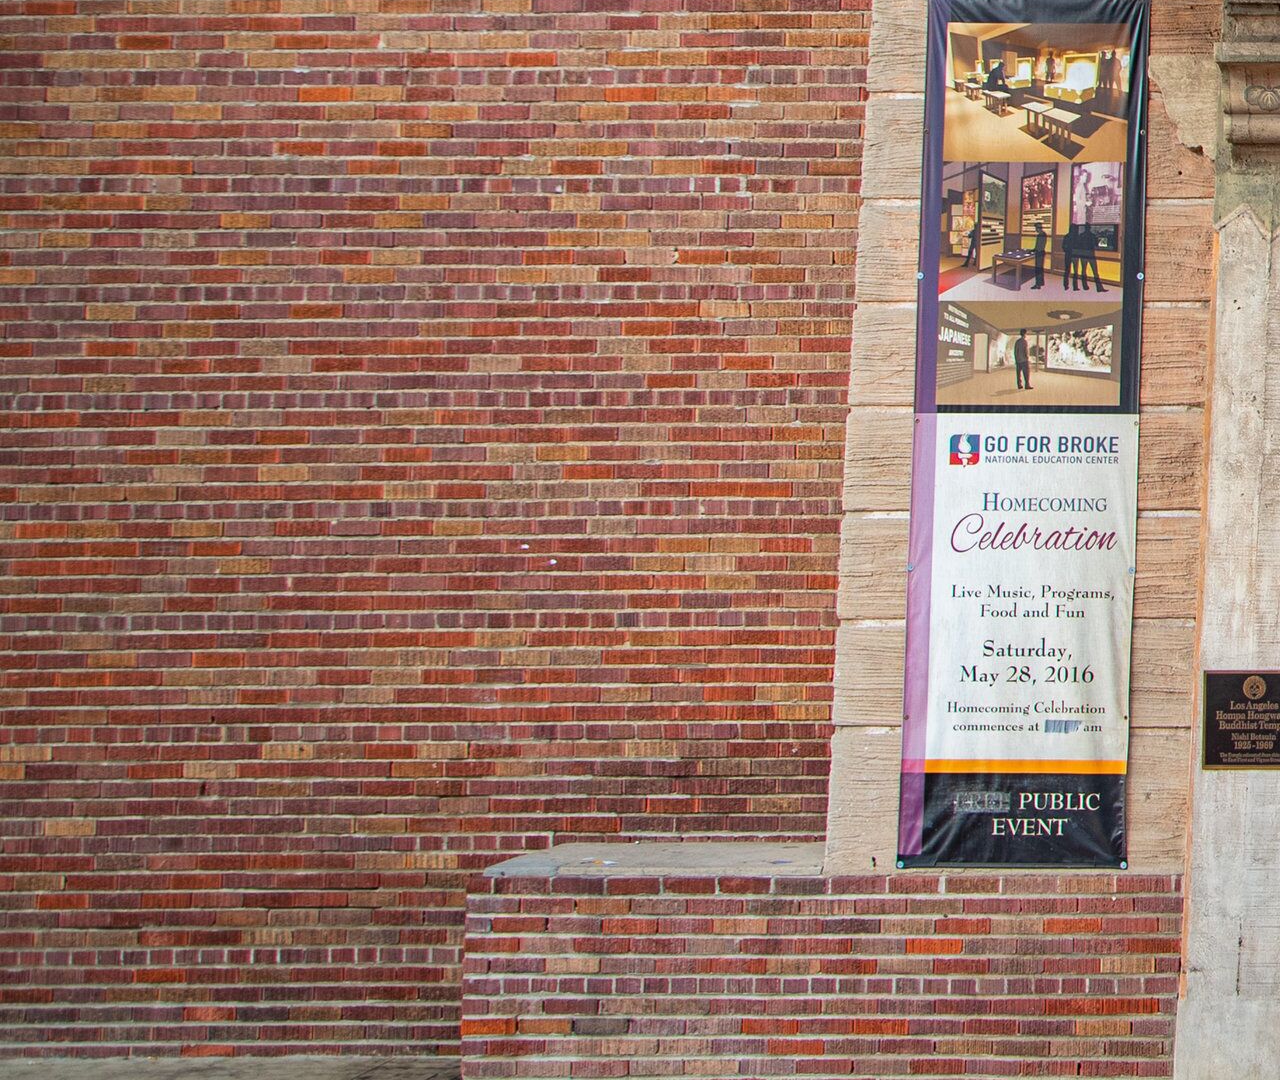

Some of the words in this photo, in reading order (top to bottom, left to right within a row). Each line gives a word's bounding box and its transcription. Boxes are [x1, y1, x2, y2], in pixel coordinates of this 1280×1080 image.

[938, 326, 972, 346] JAPANESE
[985, 436, 1008, 453] GO
[1016, 436, 1051, 453] FOR
[1058, 436, 1119, 453] BROKE
[985, 455, 1029, 464] NATIONAL
[1033, 456, 1083, 464] EDUCATION
[1086, 456, 1119, 464] CENTER
[983, 492, 1107, 512] HOMECOMING
[950, 513, 1118, 553] Celebration
[951, 585, 982, 598] Live
[987, 585, 1035, 600] Music,
[1041, 585, 1115, 602] Programs,
[980, 603, 1017, 618] Food
[1023, 603, 1049, 618] and
[1055, 604, 1085, 618] Fun
[983, 637, 1072, 661] Saturday,
[960, 665, 1000, 686] May
[1006, 665, 1037, 685] 28,
[1044, 664, 1095, 683] 2016
[947, 701, 1030, 715] Homecoming
[1034, 700, 1106, 714] Celebration
[1230, 701, 1245, 710] Los
[1246, 701, 1279, 712] Angeles
[1216, 710, 1246, 721] Hompa
[952, 722, 1024, 732] commences
[1028, 721, 1040, 732] at
[1083, 723, 1103, 732] am
[1219, 721, 1258, 730] Buddhist
[1018, 792, 1101, 811] PUBLIC
[992, 818, 1068, 836] EVENT
